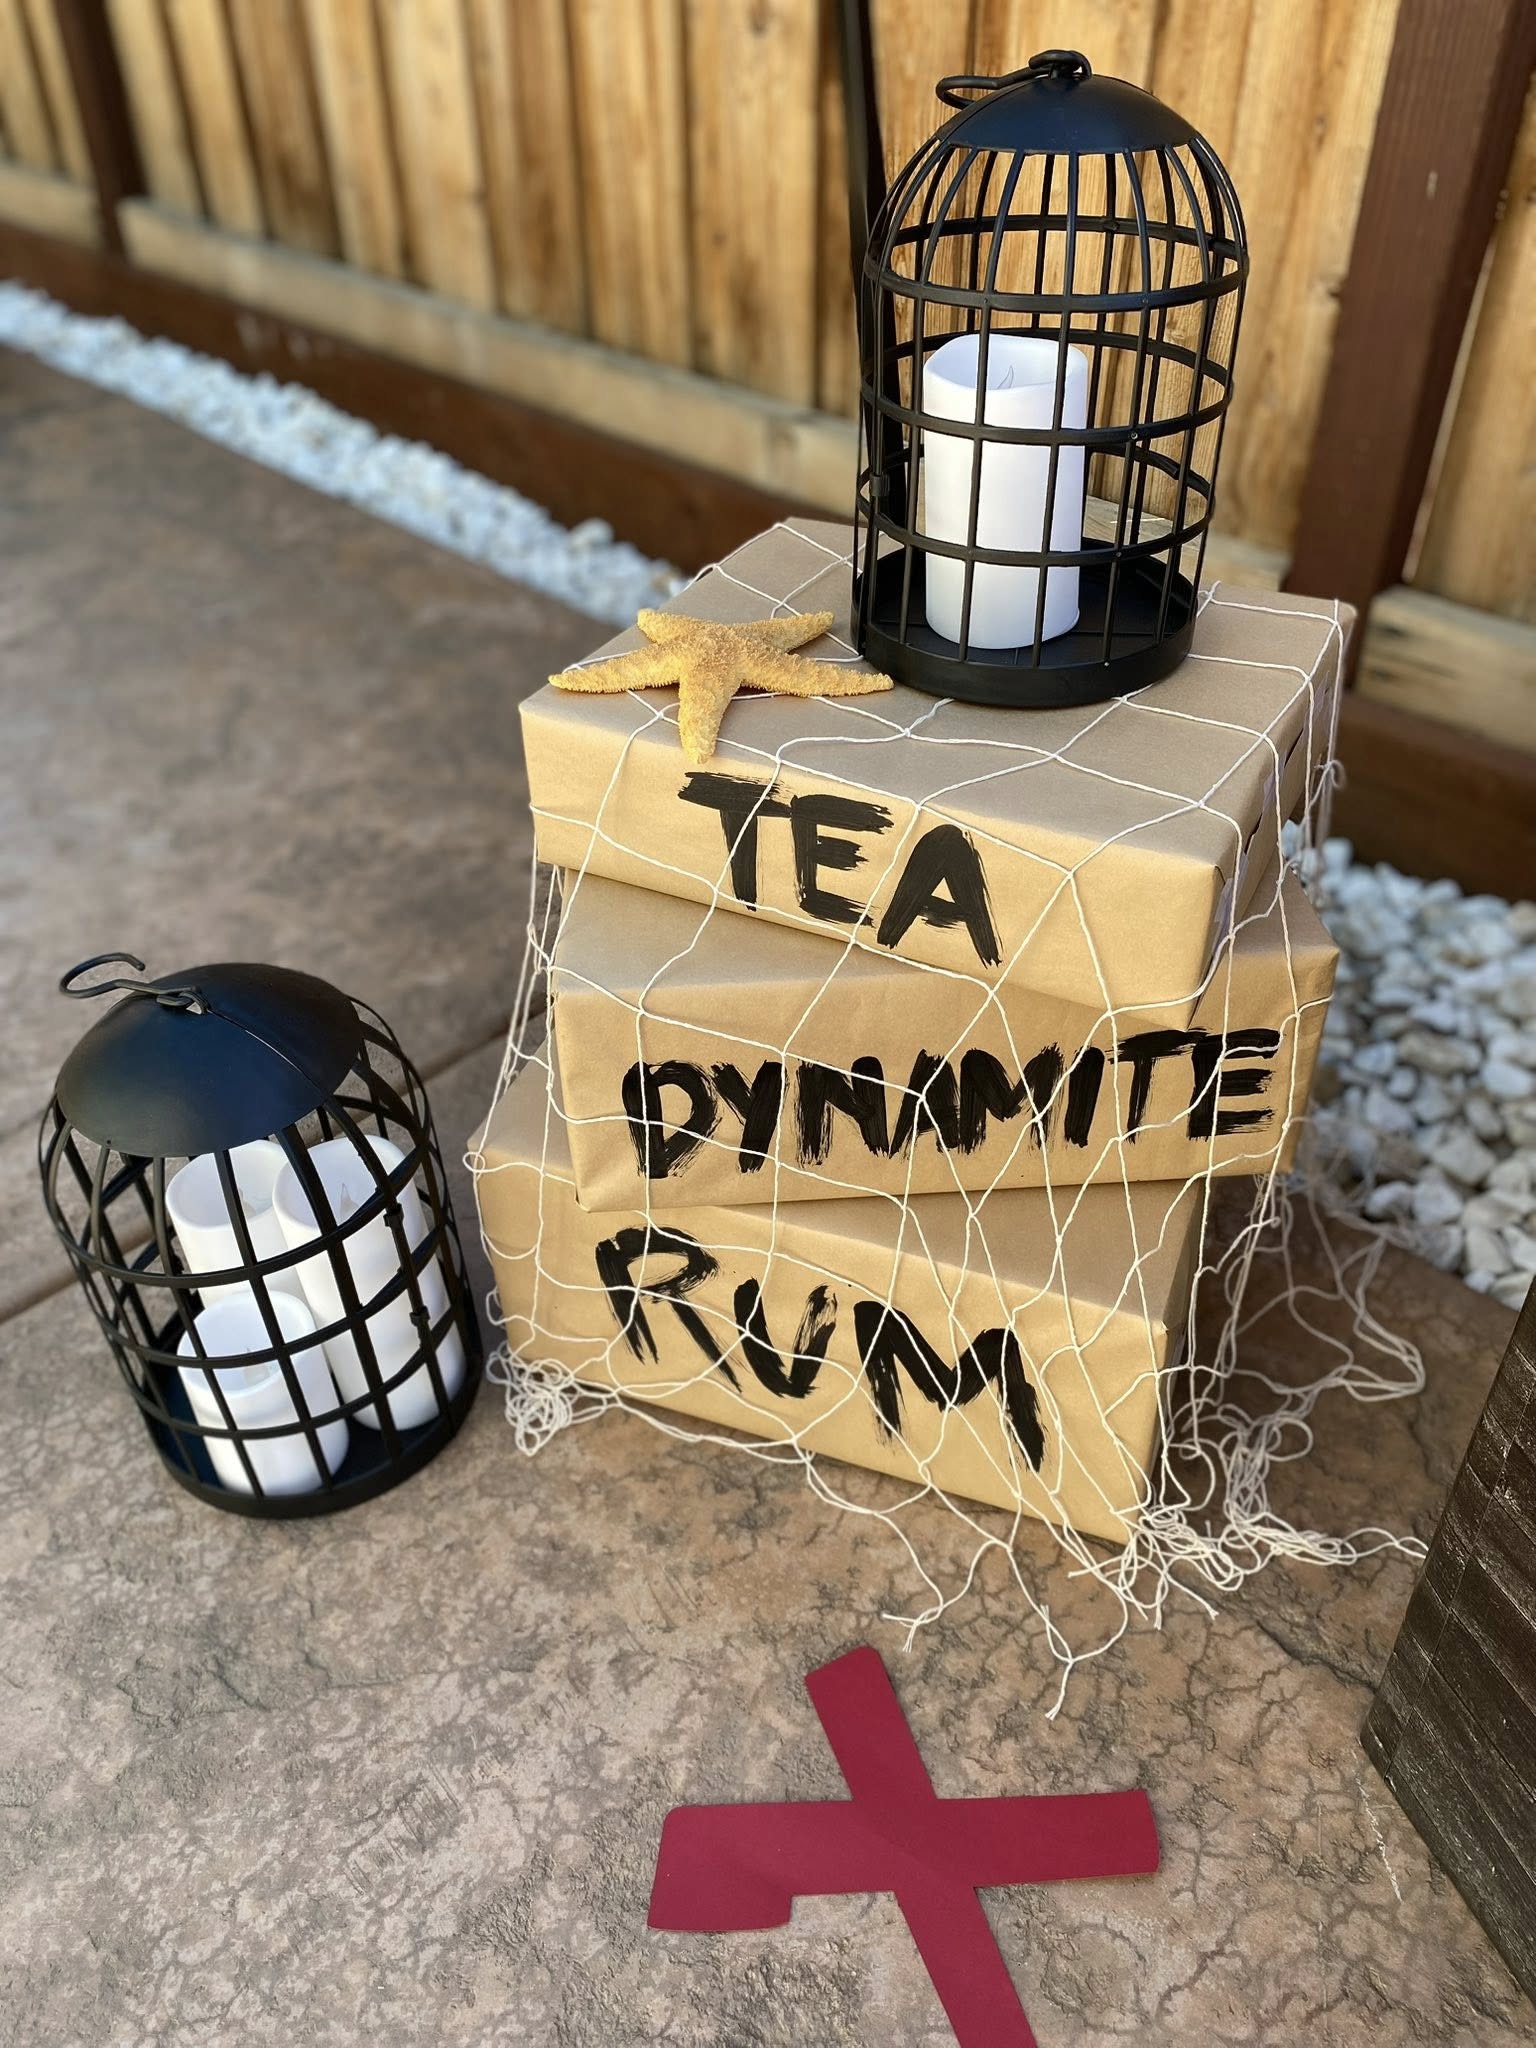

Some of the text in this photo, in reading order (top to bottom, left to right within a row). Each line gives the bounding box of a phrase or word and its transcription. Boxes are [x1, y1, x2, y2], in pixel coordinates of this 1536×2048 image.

[677, 771, 1002, 969] TEA
[621, 1028, 1282, 1180] DYNAMITE
[595, 1225, 1046, 1473] RUM
